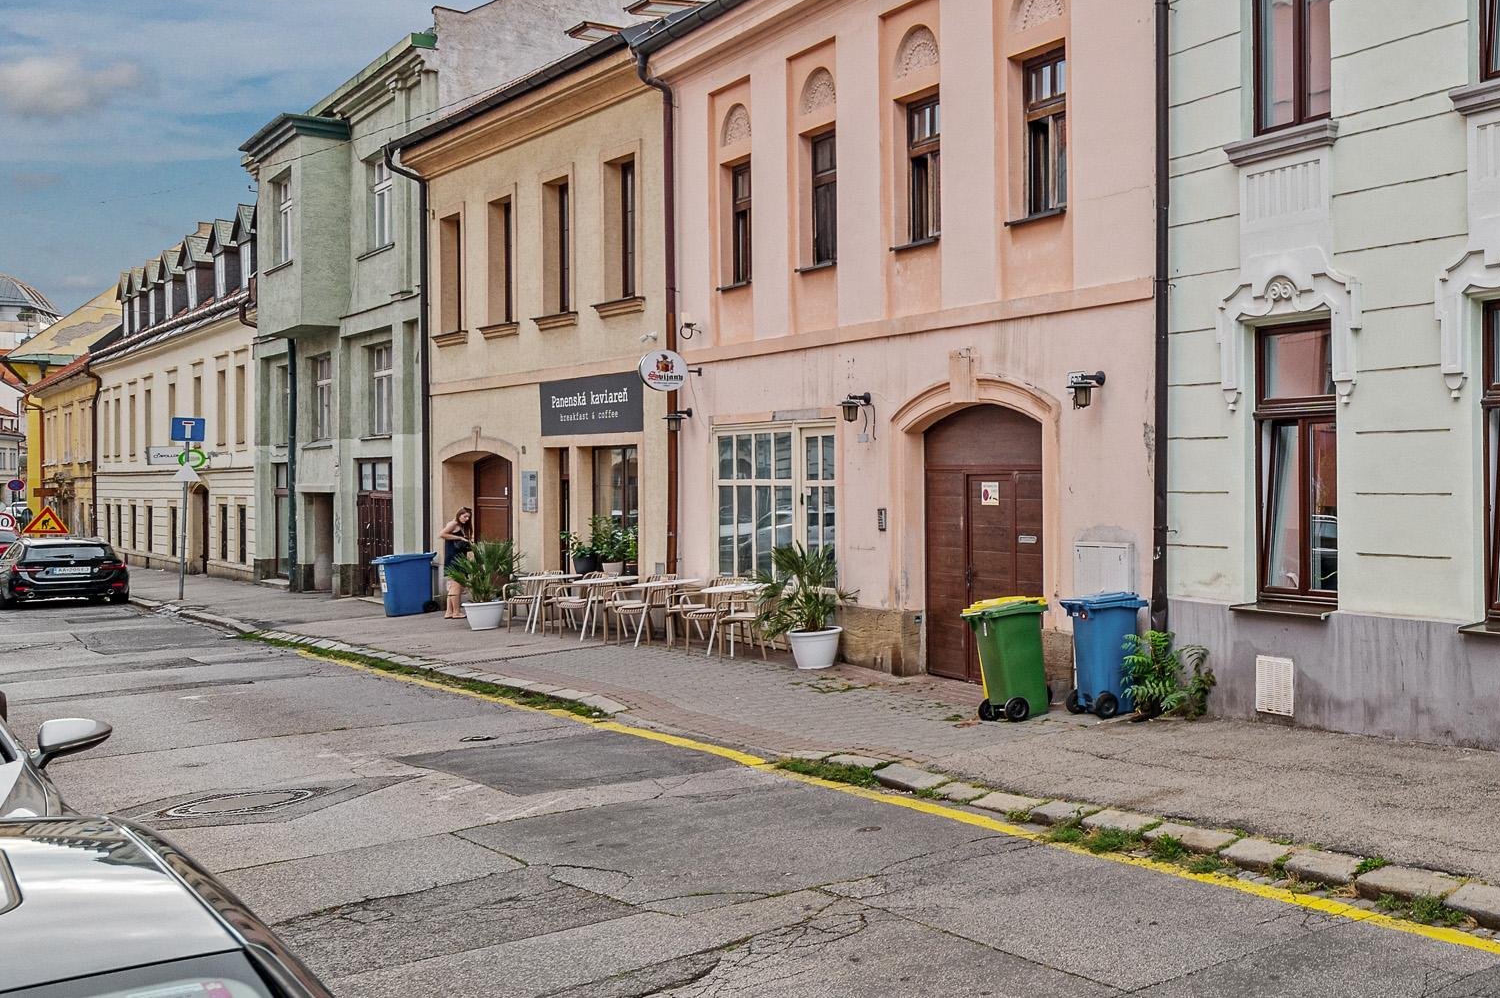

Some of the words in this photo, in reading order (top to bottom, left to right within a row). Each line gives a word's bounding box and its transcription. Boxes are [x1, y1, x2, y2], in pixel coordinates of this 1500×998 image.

[551, 391, 587, 409] Panenská
[590, 387, 629, 405] kaviareň
[560, 411, 589, 422] breakfast
[598, 409, 619, 419] coffee
